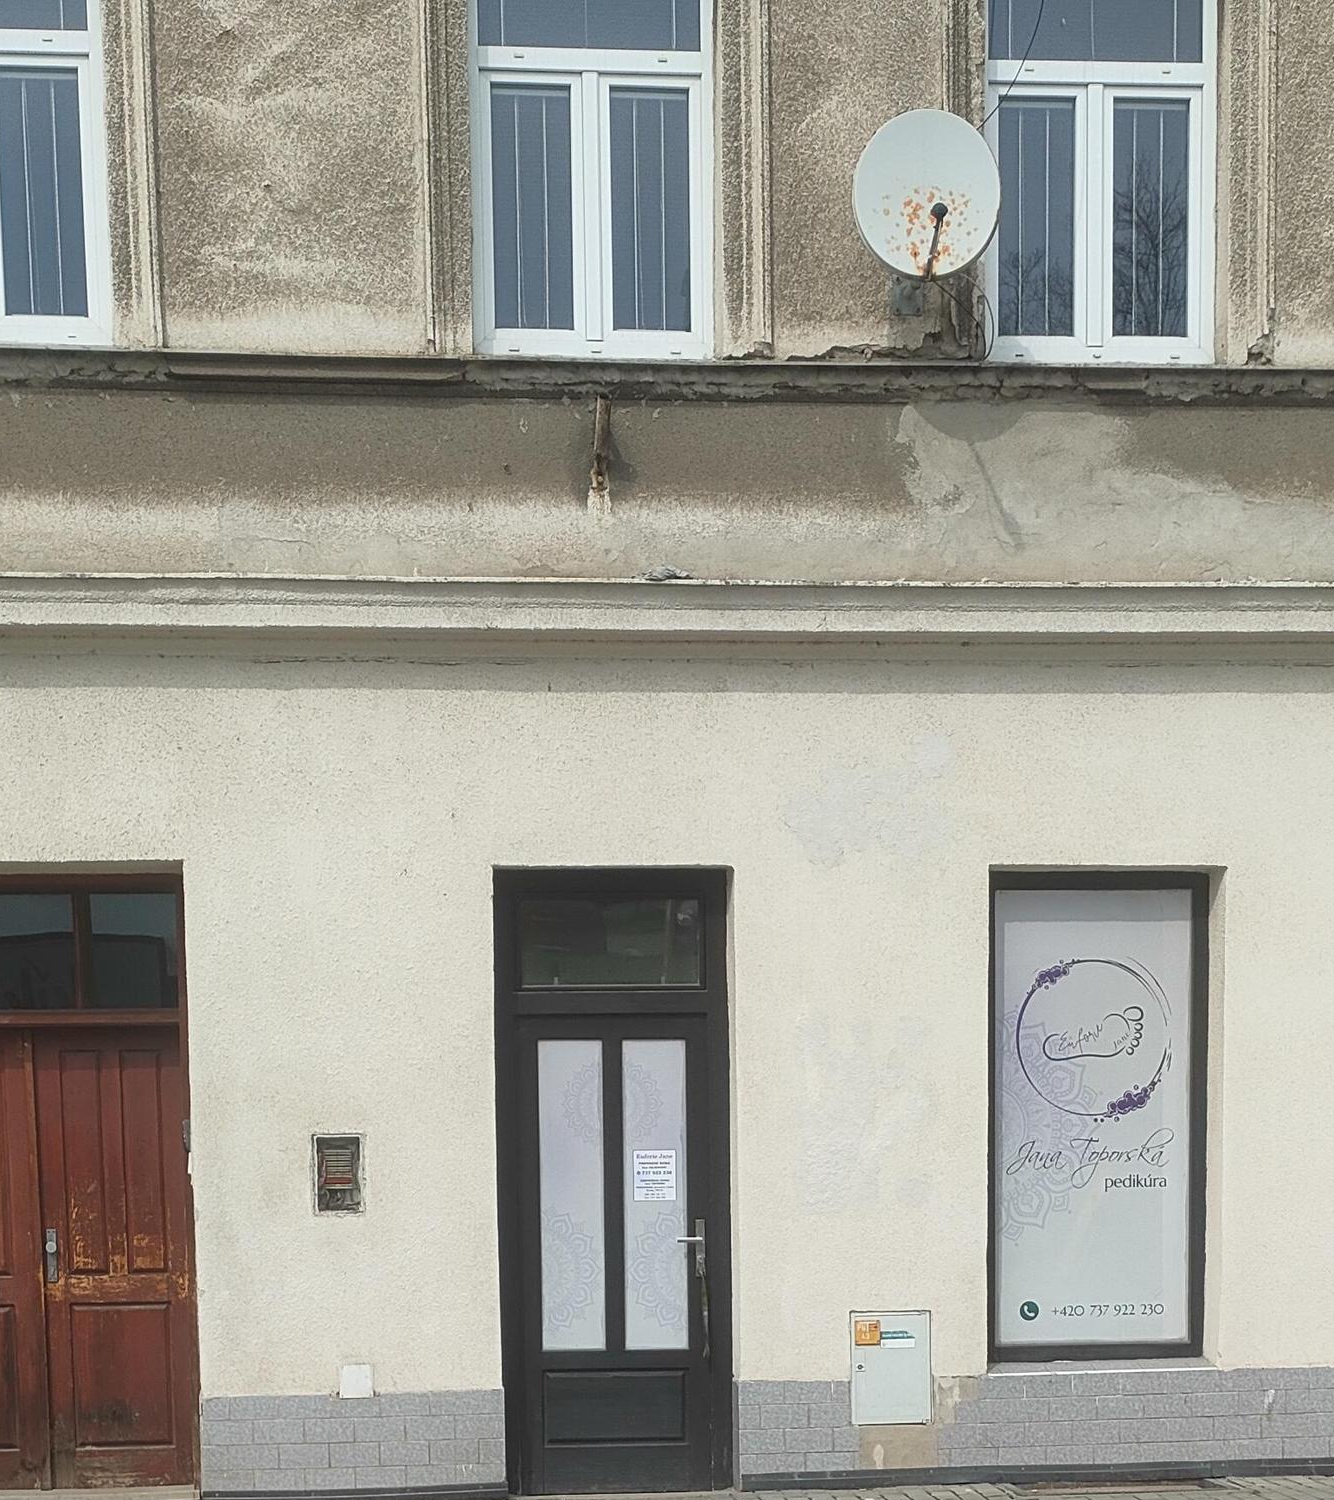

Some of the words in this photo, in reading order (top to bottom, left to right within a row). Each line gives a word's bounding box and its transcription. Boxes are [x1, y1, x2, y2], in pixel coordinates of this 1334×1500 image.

[1006, 1140, 1067, 1176] Jana
[1070, 1128, 1174, 1189] Toporská
[1104, 1174, 1167, 1192] pedikúra
[1052, 1305, 1085, 1317] +420
[1090, 1304, 1110, 1318] 737
[1114, 1304, 1136, 1317] 922
[1141, 1303, 1165, 1317] 230
